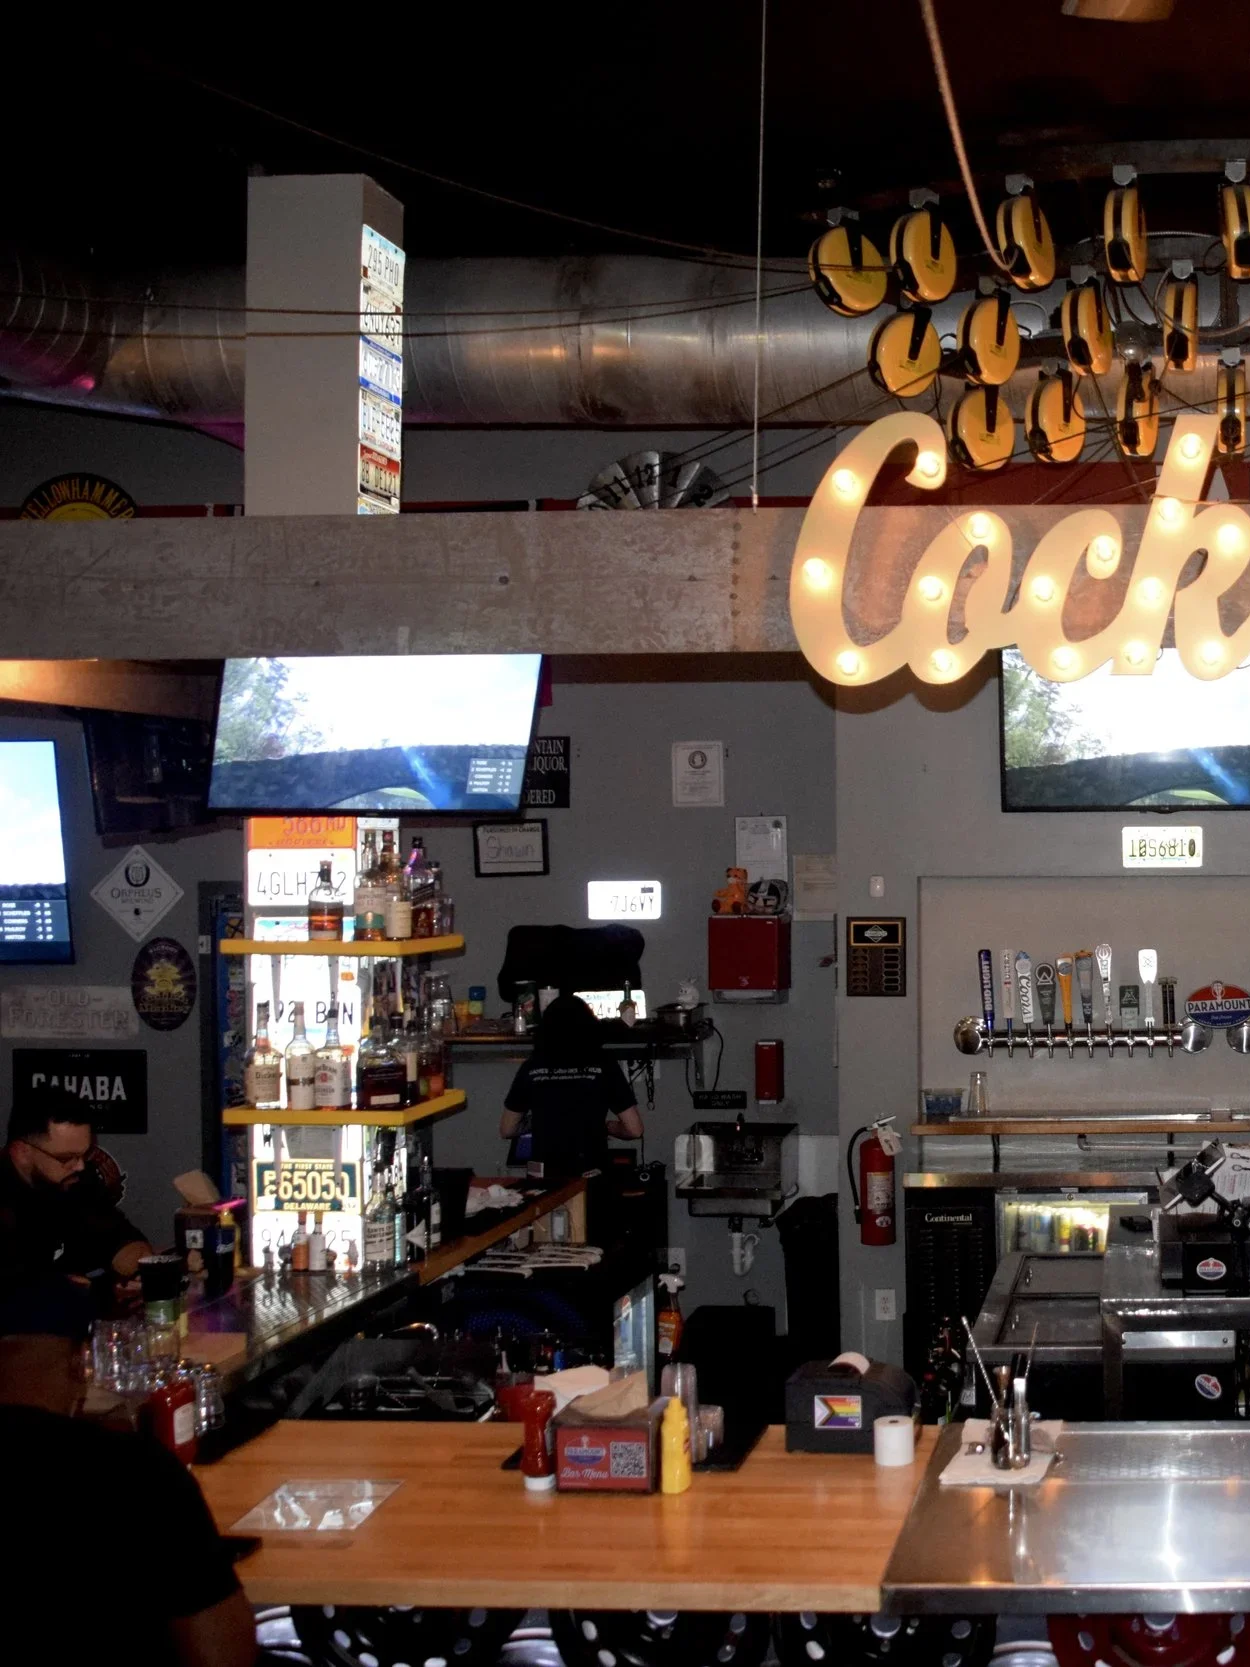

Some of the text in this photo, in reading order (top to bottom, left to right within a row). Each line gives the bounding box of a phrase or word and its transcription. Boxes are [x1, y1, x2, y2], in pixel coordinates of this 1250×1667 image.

[534, 739, 565, 754] NTAIN
[533, 756, 568, 773] IQUOR,
[257, 871, 347, 897] 4GLH72
[110, 887, 163, 899] ORPHEUS
[980, 960, 994, 1011] BUD LIGHT
[9, 1008, 130, 1030] FORESTER
[283, 1202, 331, 1211] DELAWARE
[924, 1212, 973, 1223] Continental
